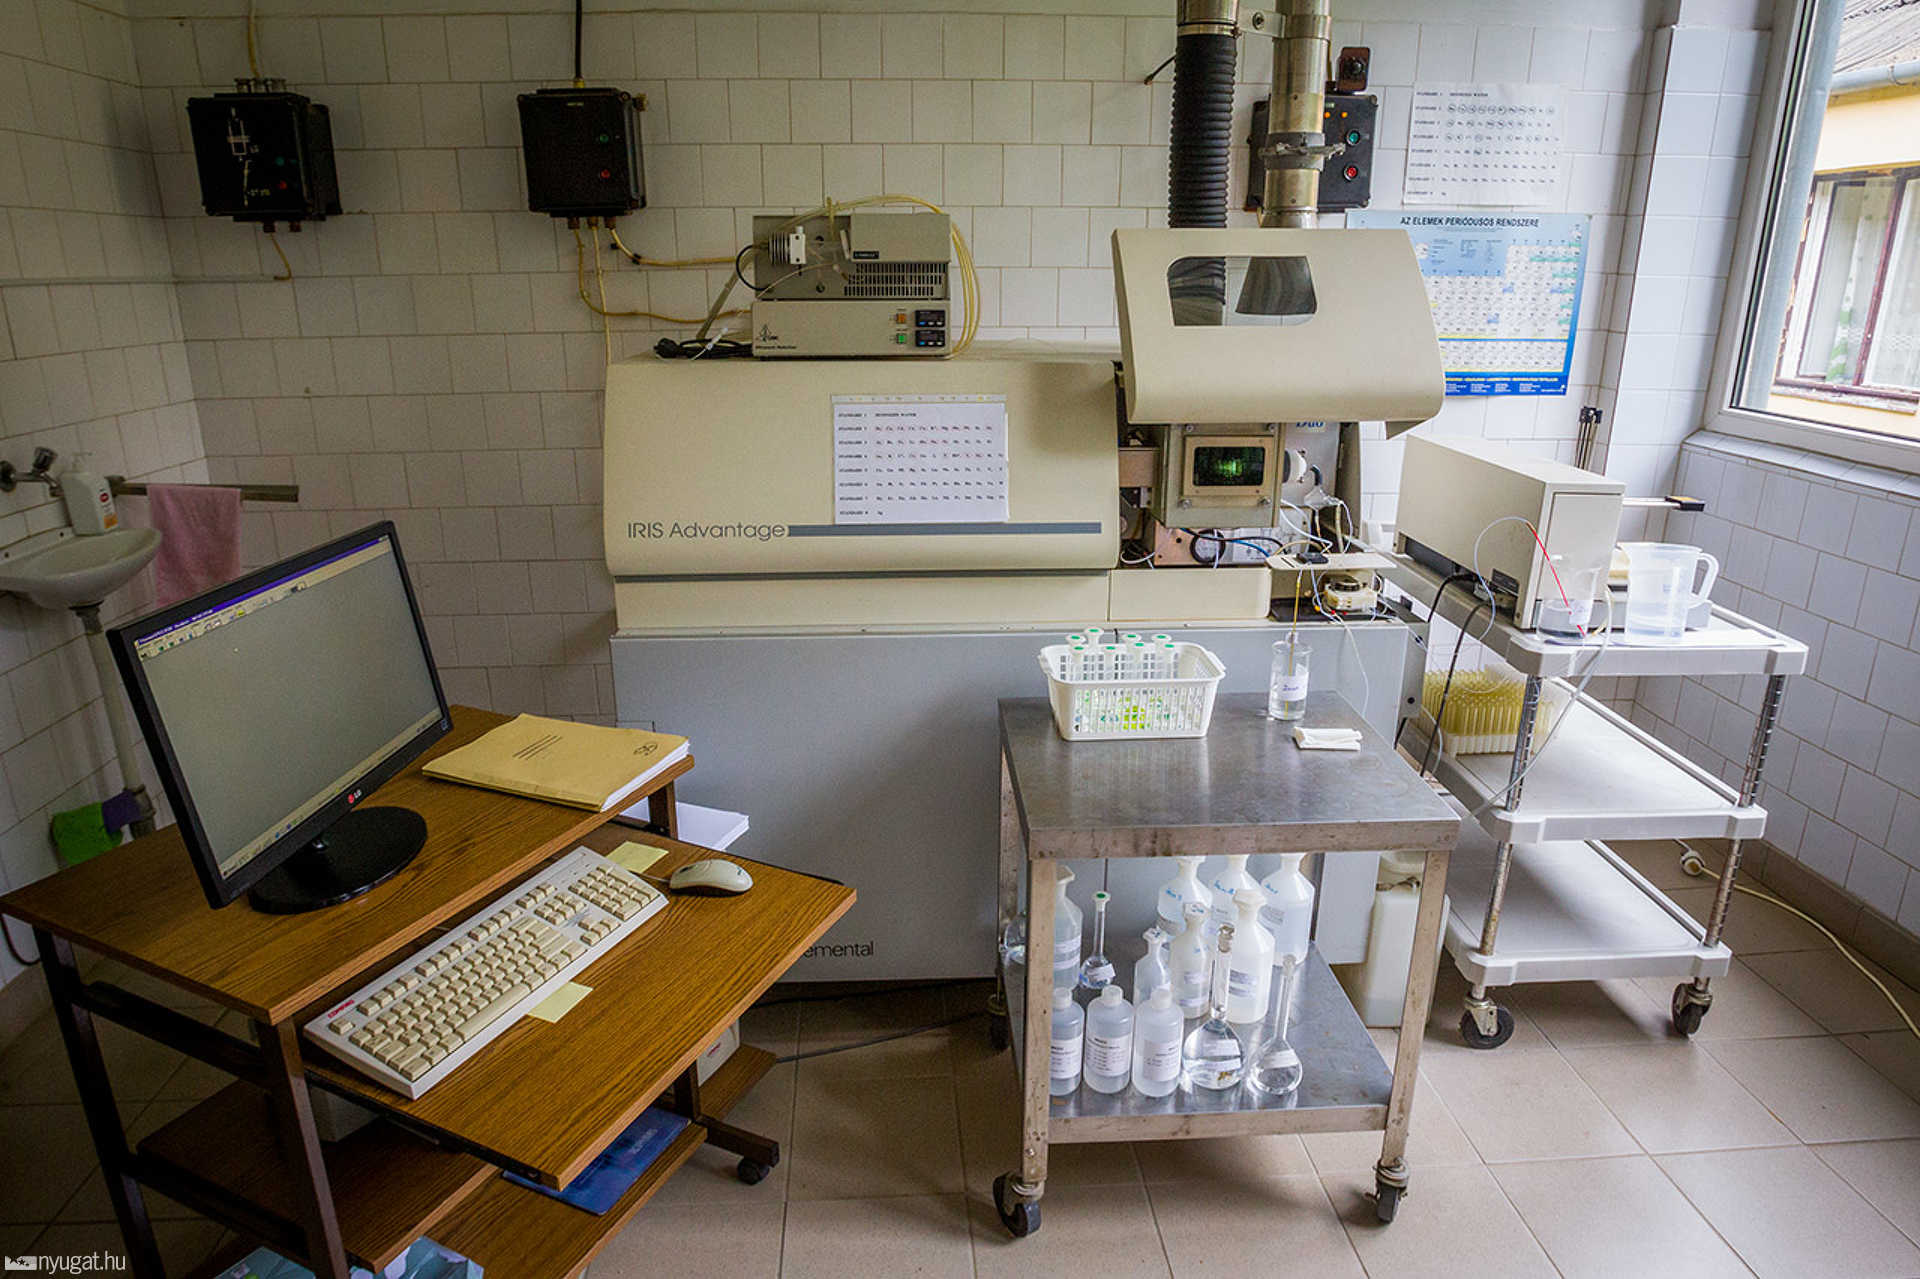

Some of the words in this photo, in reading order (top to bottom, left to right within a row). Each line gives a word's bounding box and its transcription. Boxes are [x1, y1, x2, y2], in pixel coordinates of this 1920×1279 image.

[1400, 216, 1411, 226] AZ
[1412, 216, 1444, 226] ELEMEK
[1495, 217, 1539, 228] RENDSZERE
[628, 521, 664, 539] IRIS
[669, 521, 786, 542] Advantage
[803, 941, 874, 958] emental
